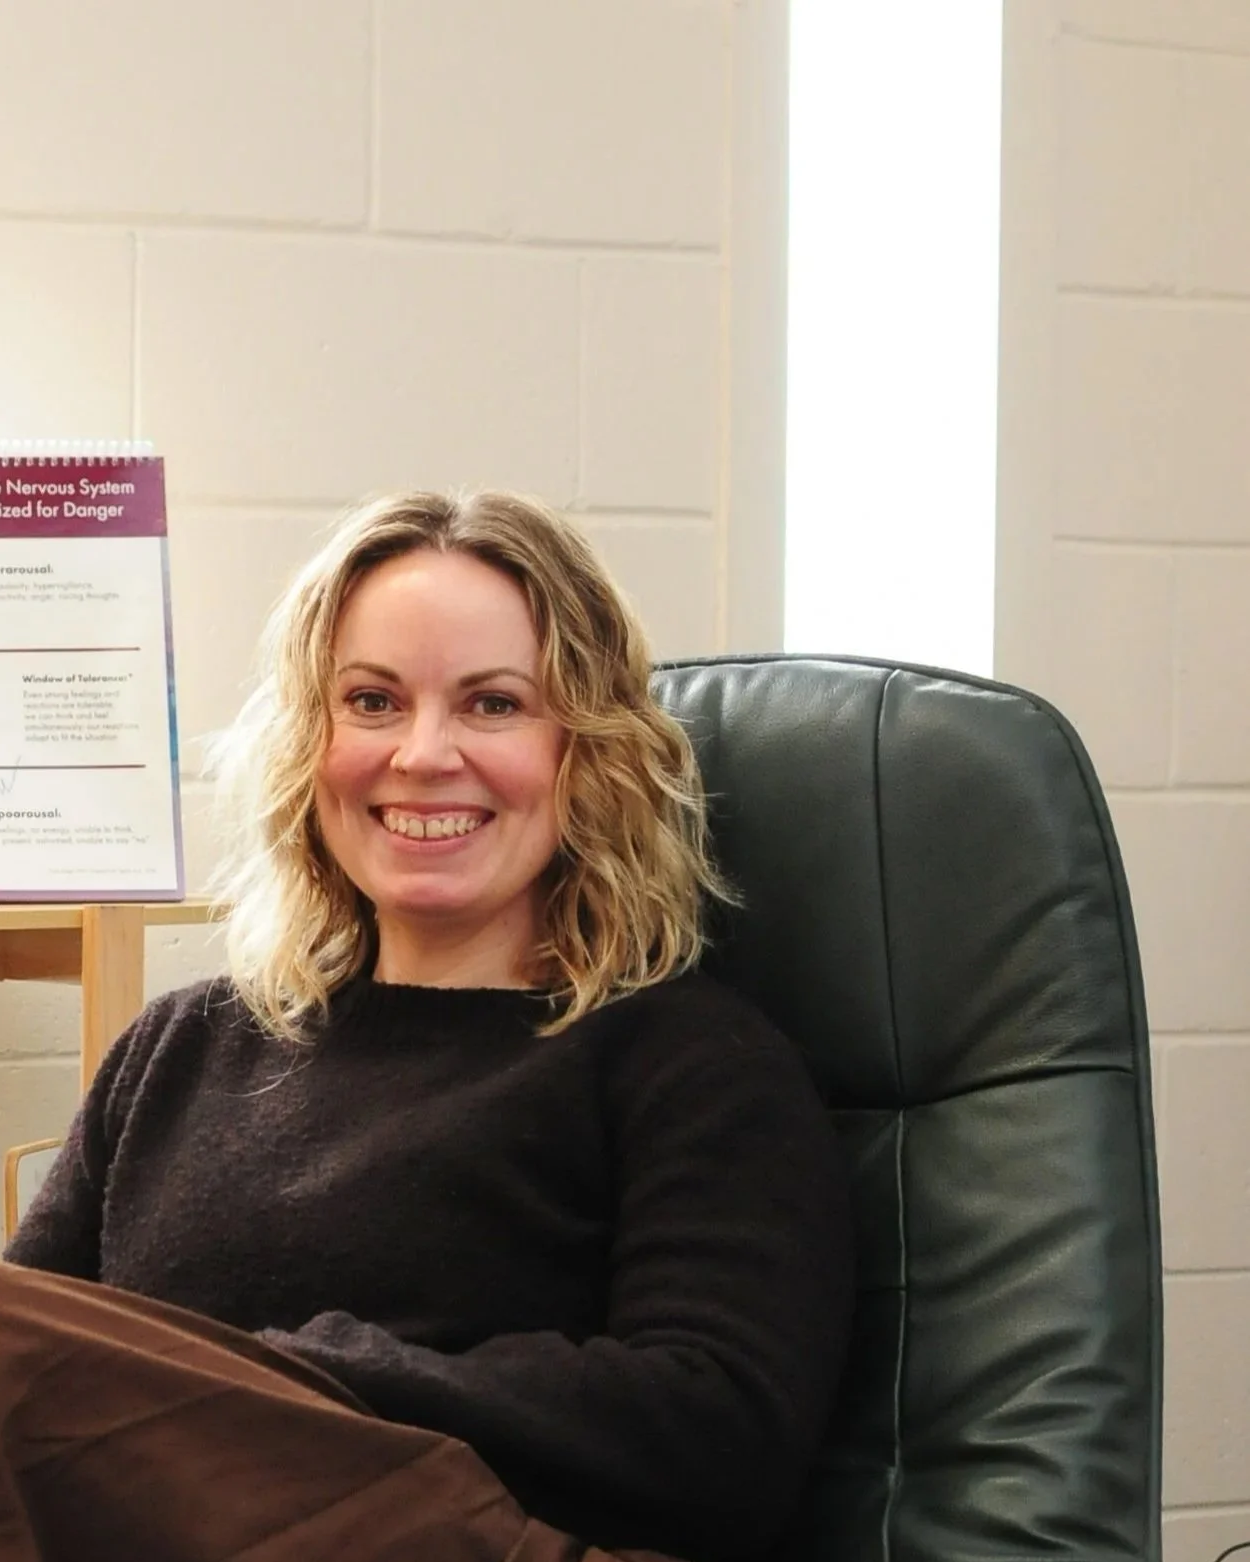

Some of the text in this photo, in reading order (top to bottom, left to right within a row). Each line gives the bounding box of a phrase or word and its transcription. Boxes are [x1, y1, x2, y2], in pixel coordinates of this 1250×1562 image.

[6, 479, 75, 495] Nervous
[79, 478, 135, 498] System
[36, 500, 58, 518] for
[63, 501, 124, 521] Danger
[22, 674, 62, 682] Window
[66, 674, 76, 682] of
